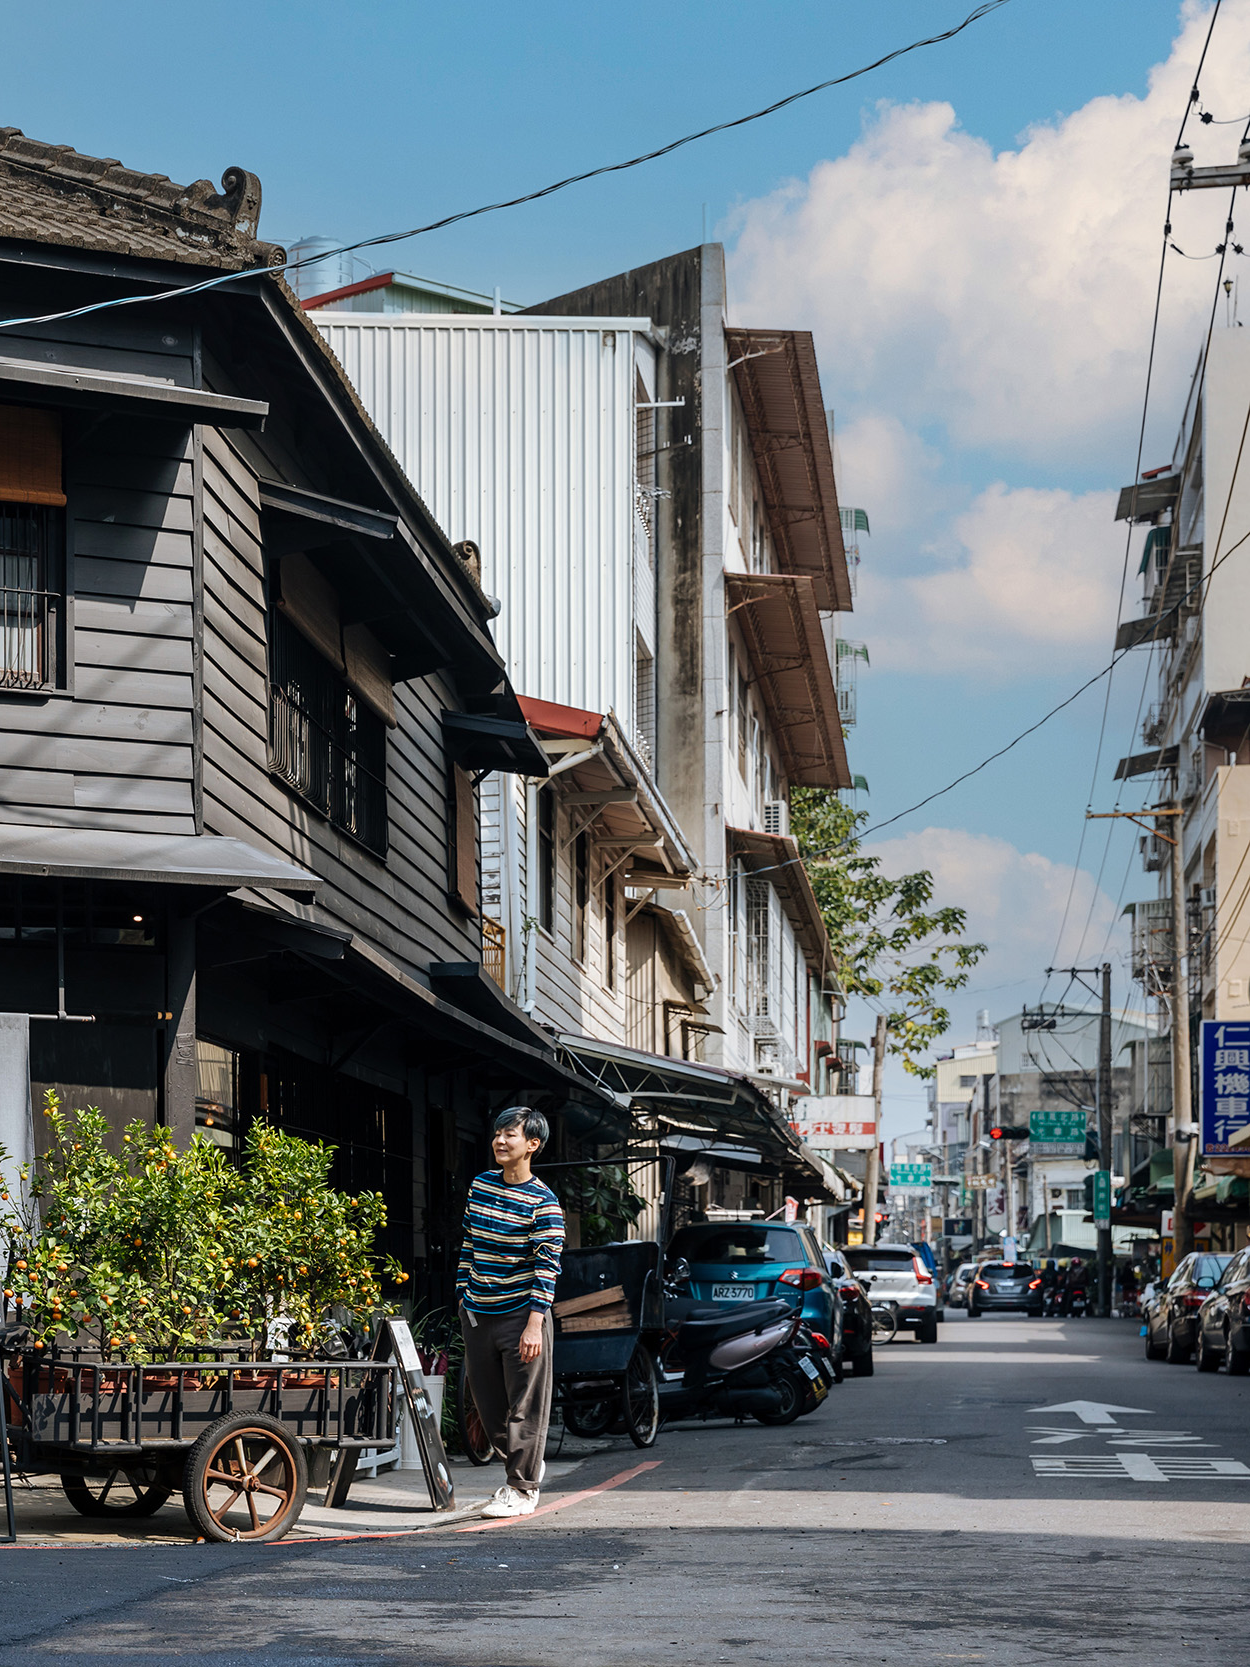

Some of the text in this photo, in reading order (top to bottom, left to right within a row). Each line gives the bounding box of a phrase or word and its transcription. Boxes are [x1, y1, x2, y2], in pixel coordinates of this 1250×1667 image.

[1213, 1025, 1250, 1142] 仁興機車行
[713, 1287, 754, 1298] ARZ-3770
